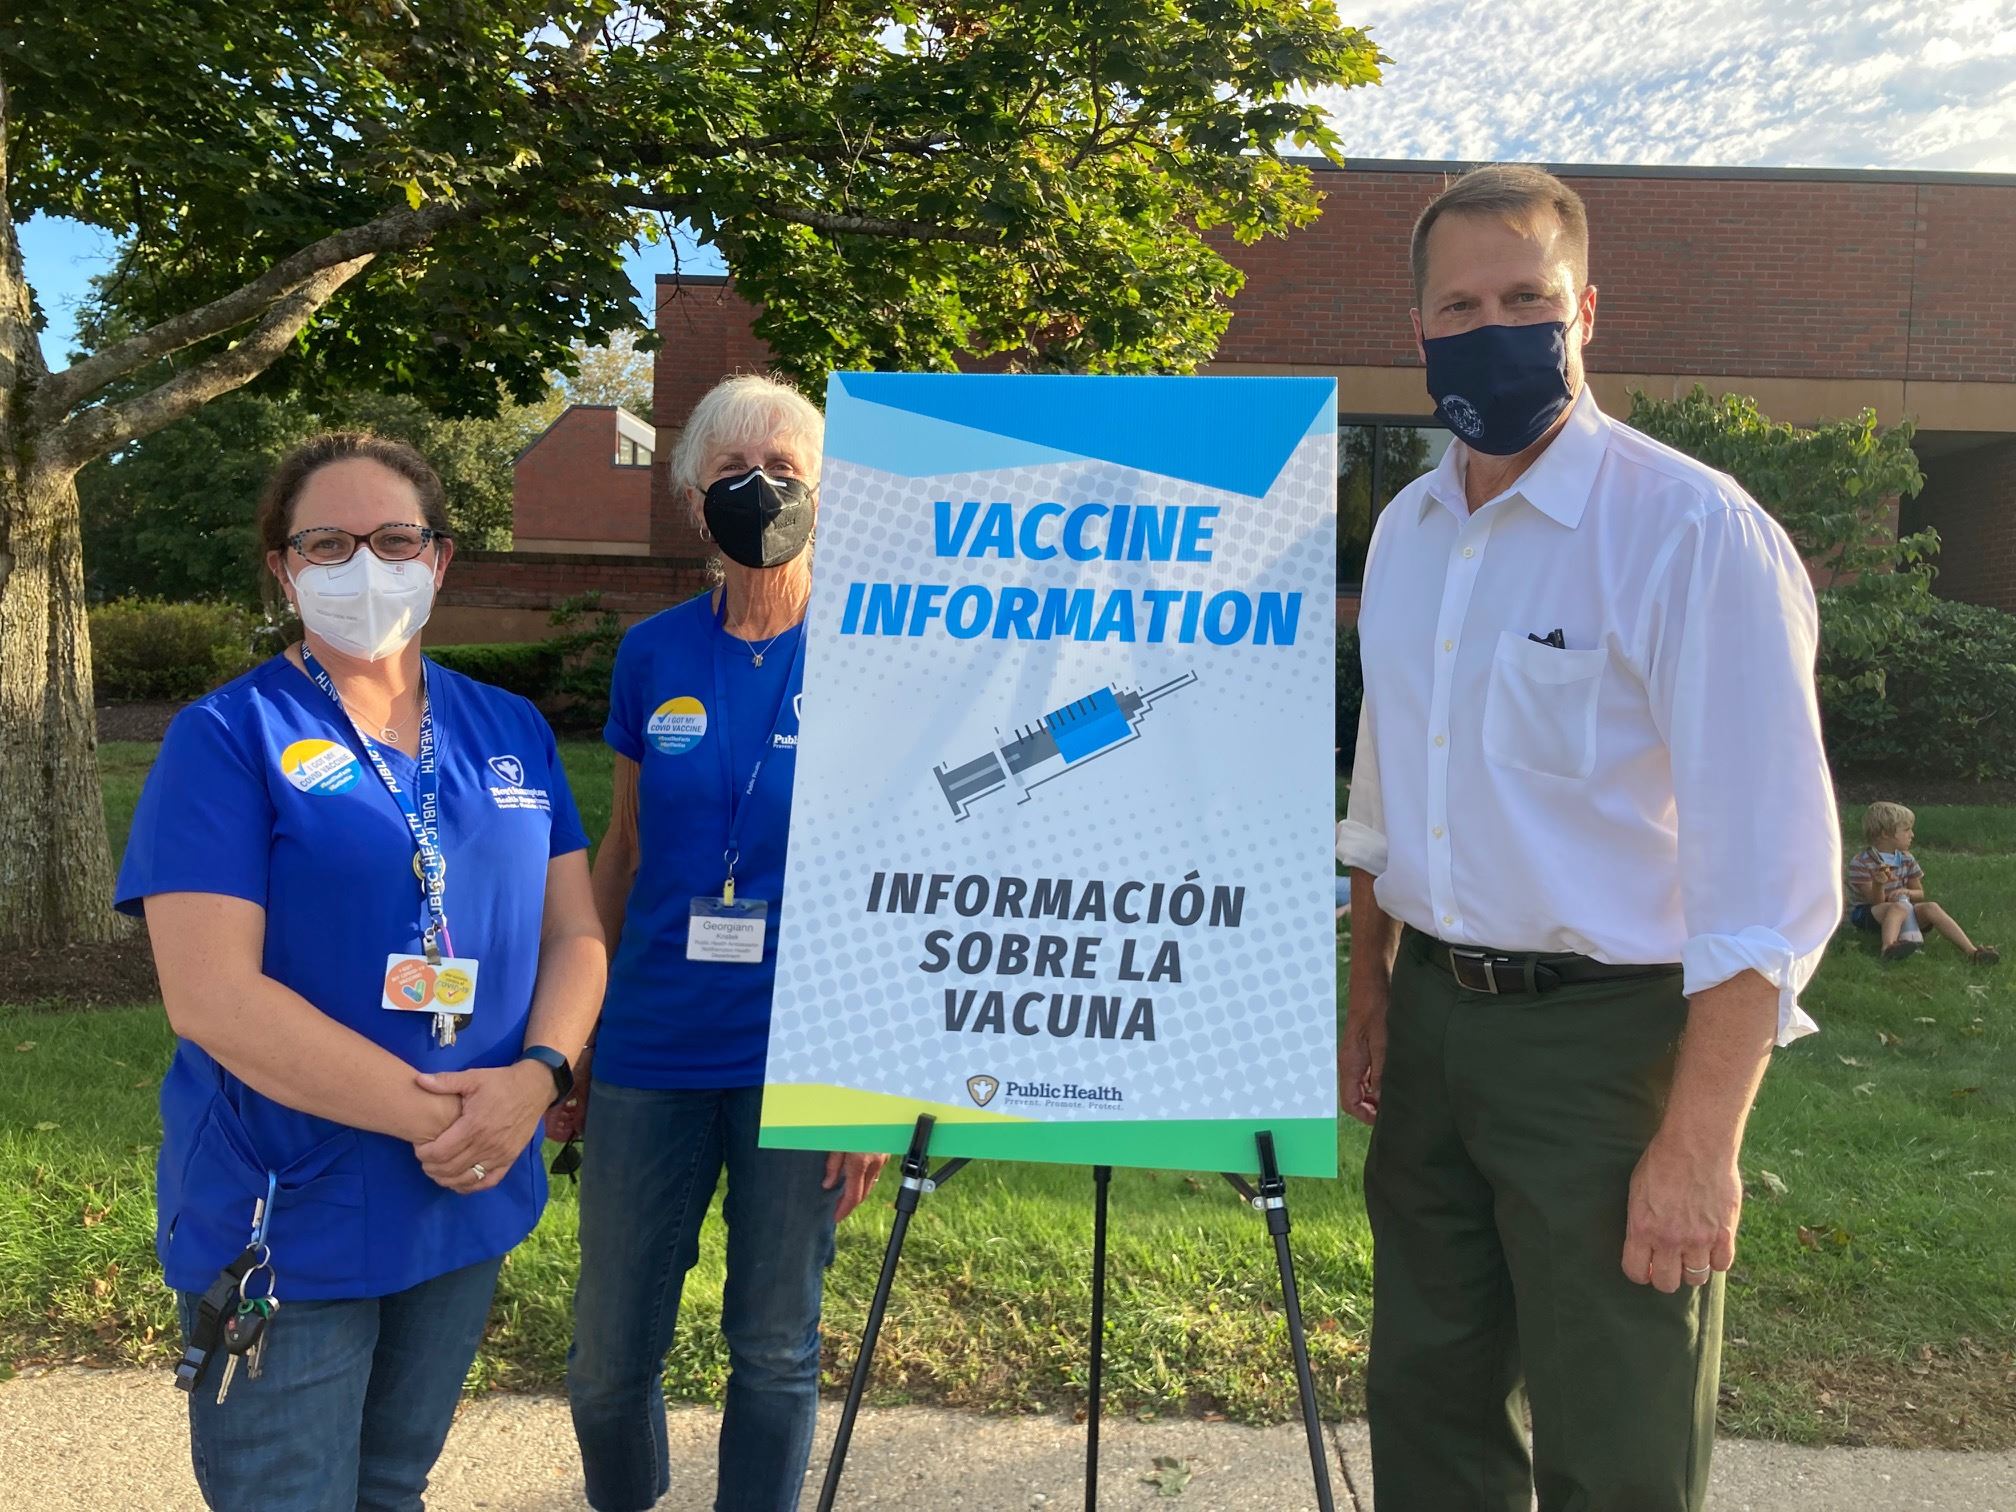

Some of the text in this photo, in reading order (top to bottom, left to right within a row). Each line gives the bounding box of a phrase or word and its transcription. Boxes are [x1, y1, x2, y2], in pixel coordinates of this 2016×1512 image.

[933, 501, 1220, 562] VACCINE
[840, 583, 1302, 646] INFORMATION
[421, 728, 435, 774] HEALTH
[650, 724, 703, 733] COVID VACCINE
[300, 769, 323, 788] COVID
[368, 749, 402, 793] PUBLIC
[422, 793, 438, 840] PUBLIC
[406, 813, 438, 867] HEALTH
[865, 870, 1245, 928] INFORMACIÓN
[703, 919, 754, 934] Georgiann
[918, 929, 1183, 983] SOBRE LA
[943, 988, 1156, 1041] VACUNA
[1004, 1098, 1125, 1111] Prevent. Promote. Protect.
[1006, 1082, 1123, 1101] Public Health
